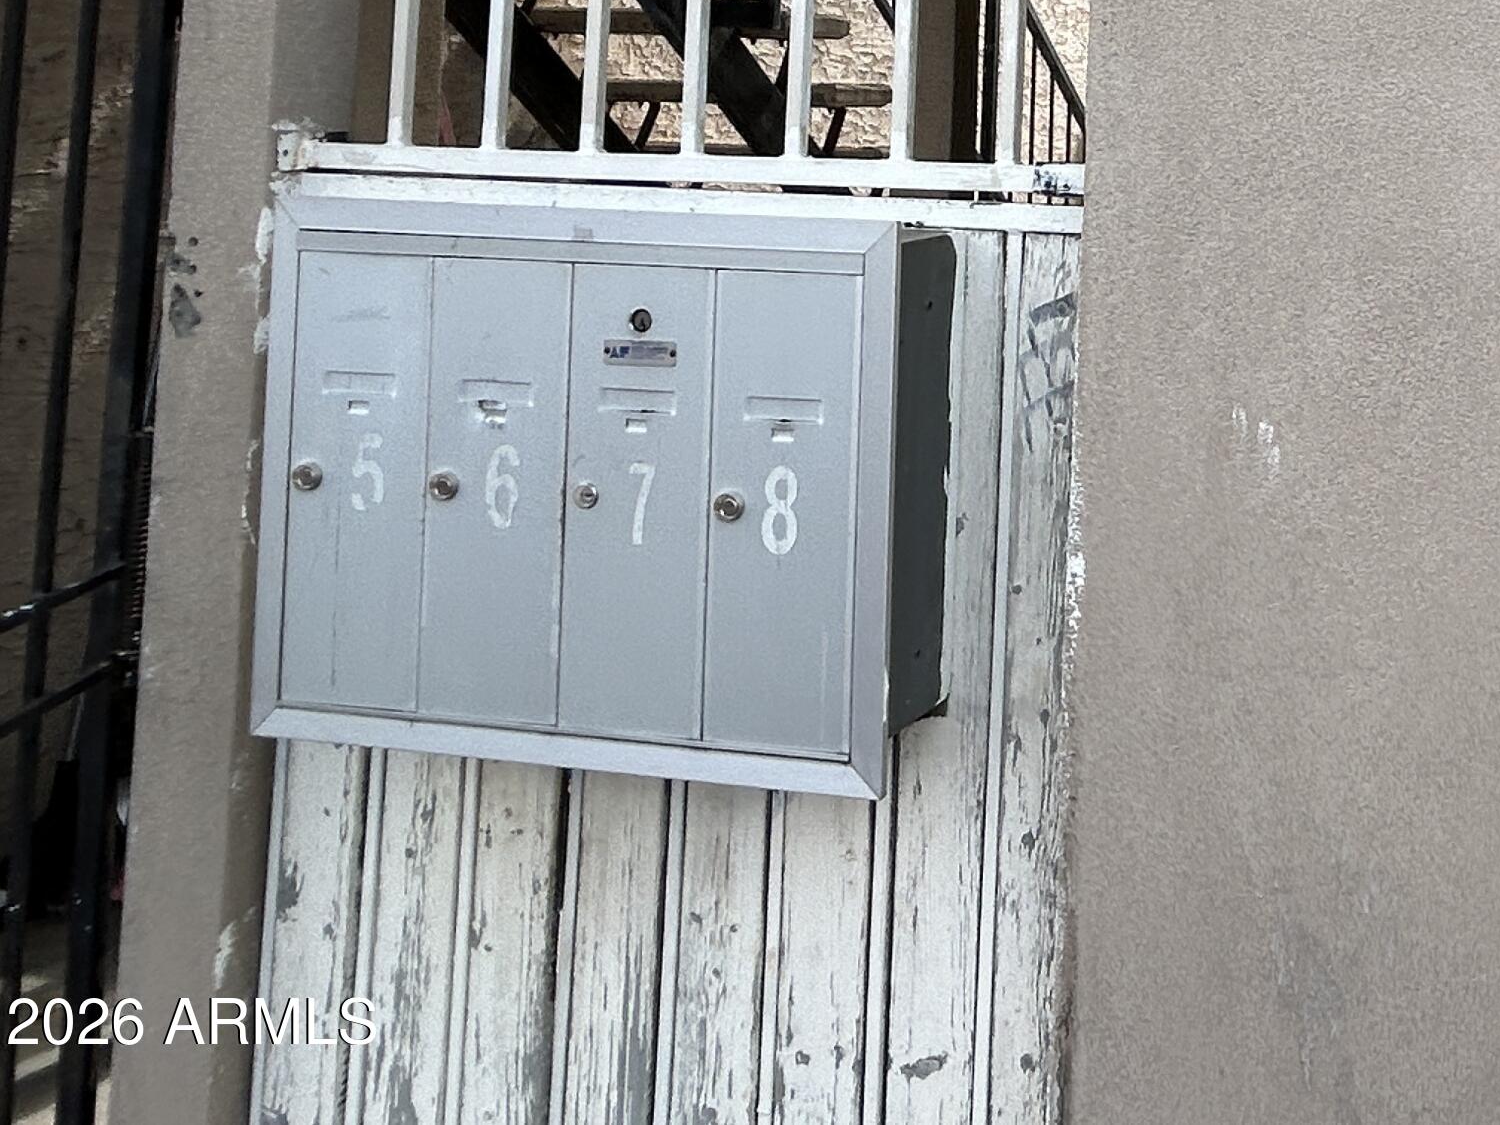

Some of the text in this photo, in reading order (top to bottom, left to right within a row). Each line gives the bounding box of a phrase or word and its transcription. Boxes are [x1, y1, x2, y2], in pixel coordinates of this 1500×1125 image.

[350, 432, 384, 511] 5
[485, 444, 521, 529] 6
[628, 460, 656, 546] 7
[760, 465, 798, 555] 8
